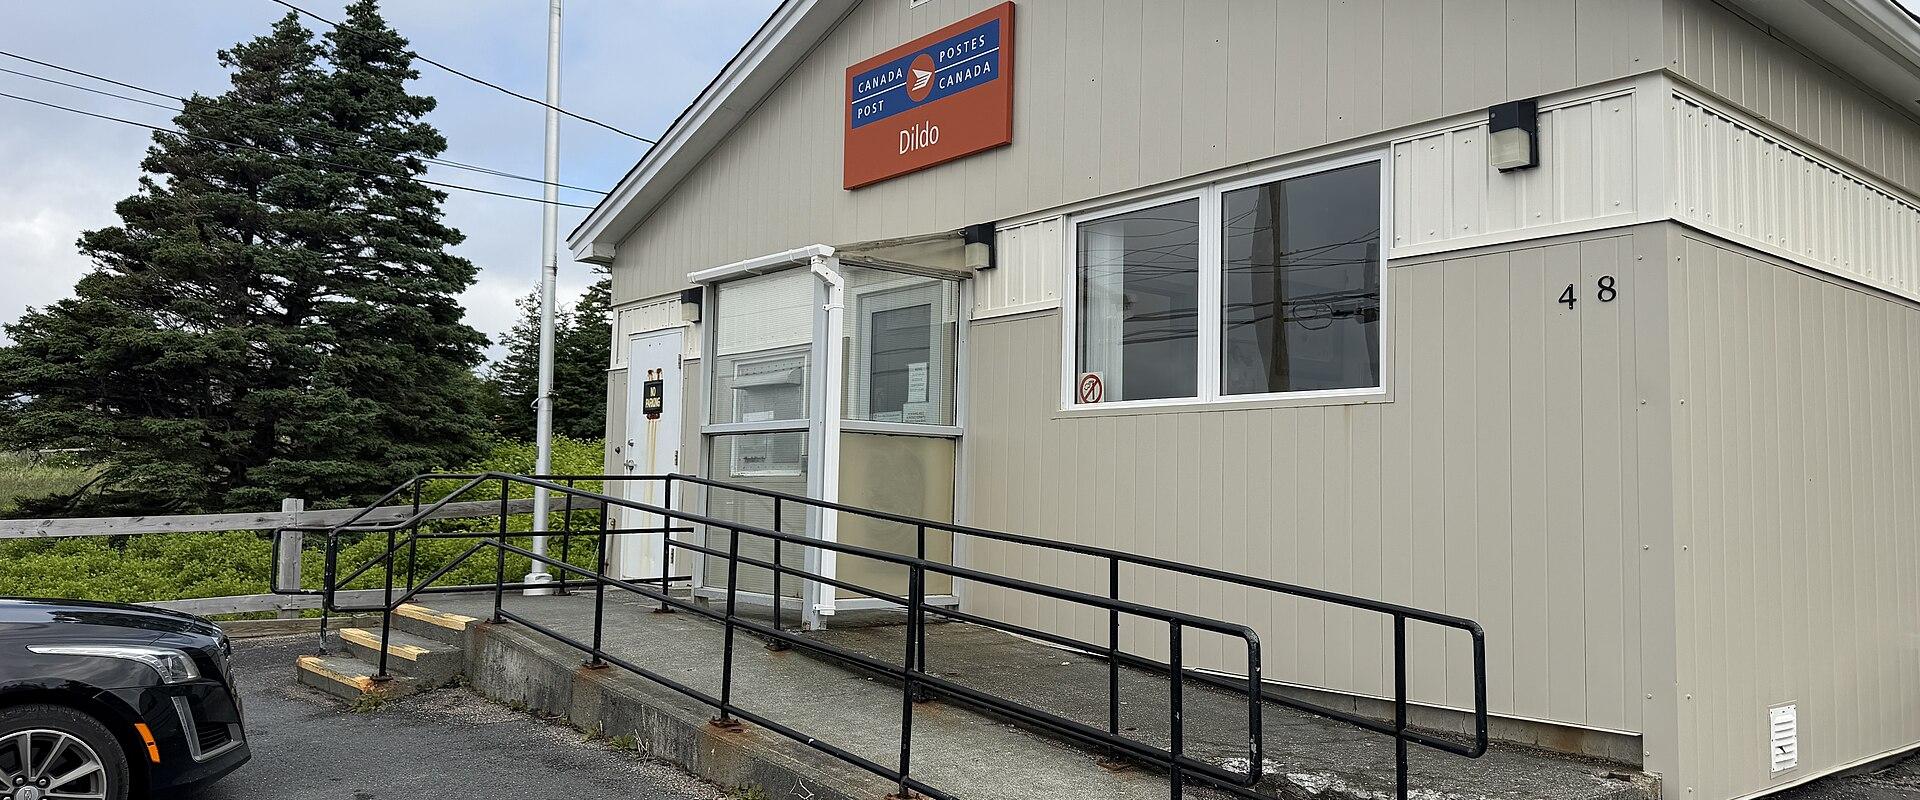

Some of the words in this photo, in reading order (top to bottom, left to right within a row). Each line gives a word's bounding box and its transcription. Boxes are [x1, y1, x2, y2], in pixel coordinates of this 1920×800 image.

[939, 35, 985, 62] POSTES
[858, 68, 903, 93] CANADA
[939, 61, 991, 89] CANADA
[857, 100, 884, 119] POST
[899, 120, 939, 155] Dildo
[1558, 283, 1577, 310] 4
[1597, 275, 1617, 302] 8
[650, 386, 657, 397] NO
